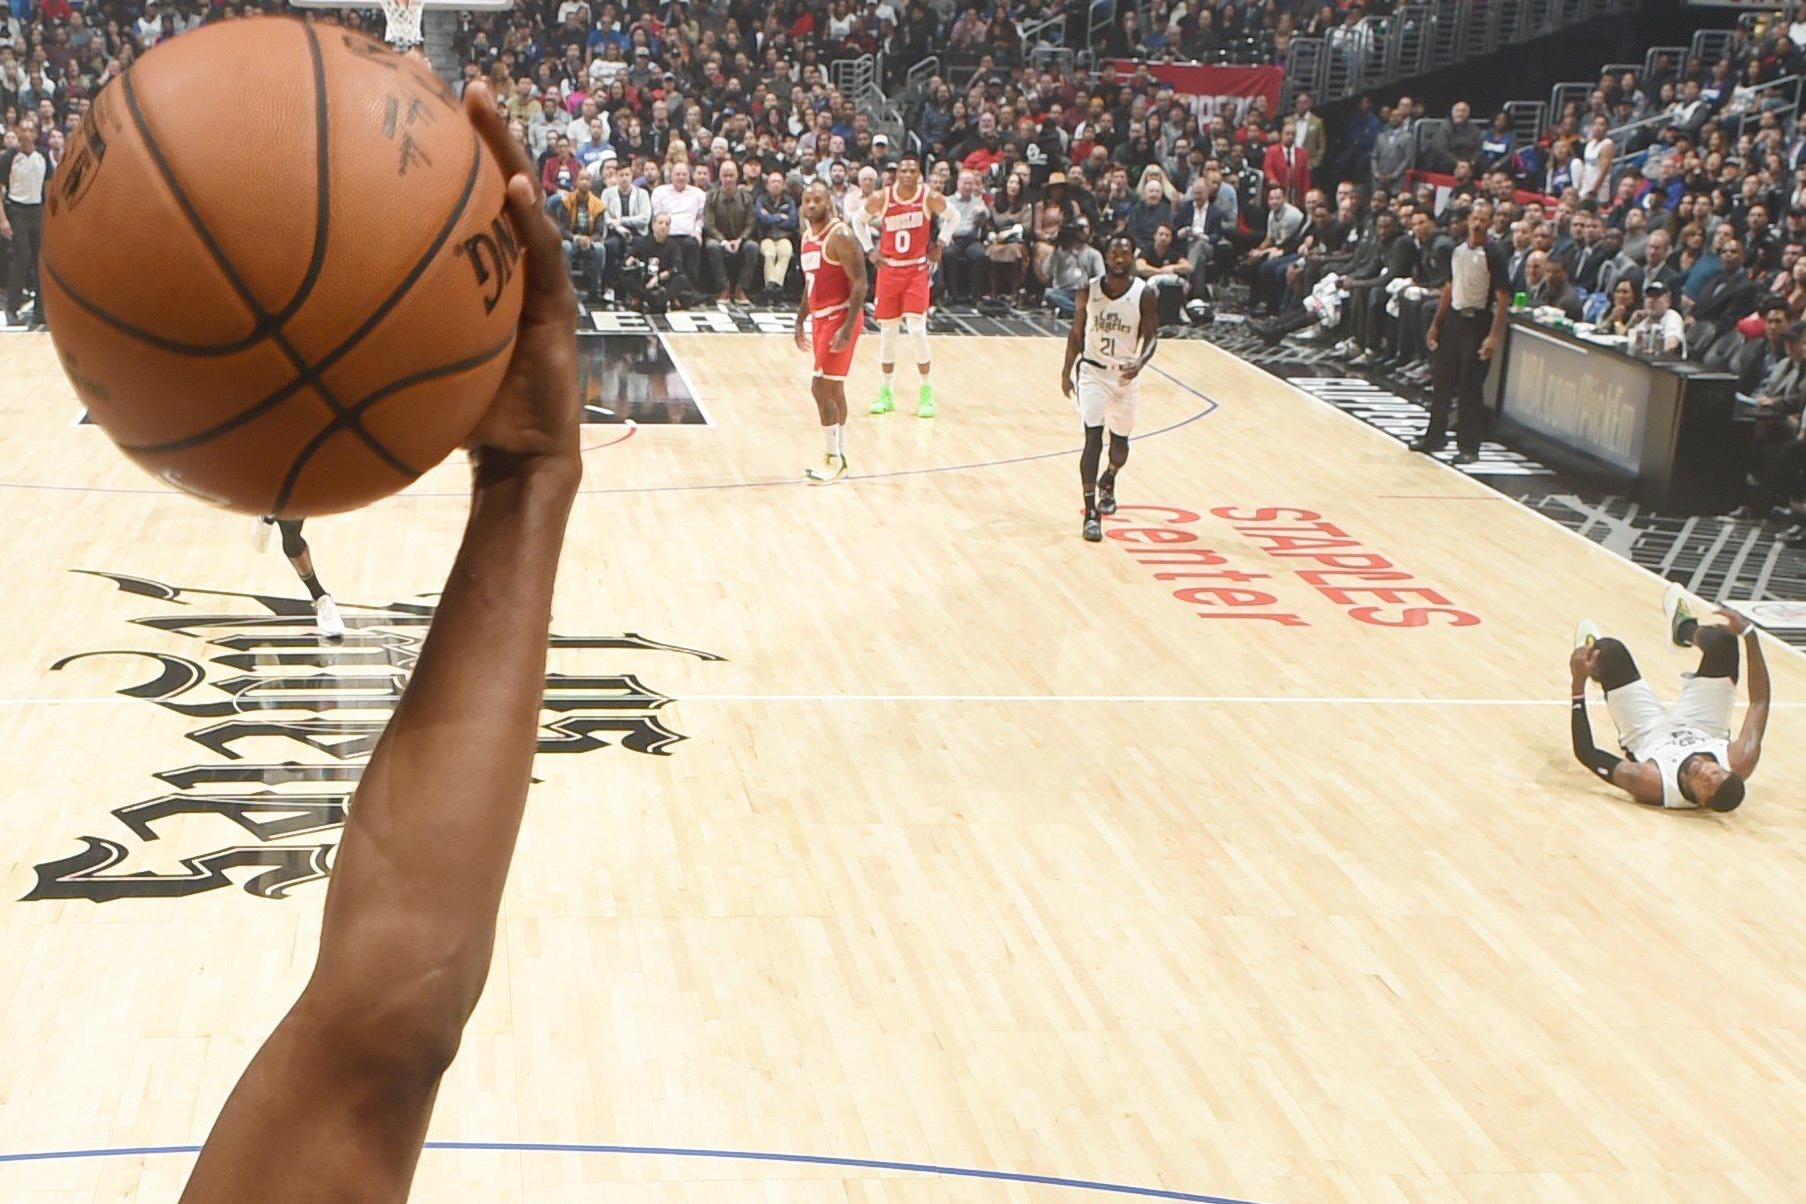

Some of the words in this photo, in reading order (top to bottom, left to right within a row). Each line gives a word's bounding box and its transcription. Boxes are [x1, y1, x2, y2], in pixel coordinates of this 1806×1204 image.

[895, 230, 911, 254] 0
[1100, 337, 1116, 356] 21
[1080, 504, 1312, 628] Center
[1209, 505, 1482, 628] STAPLES
